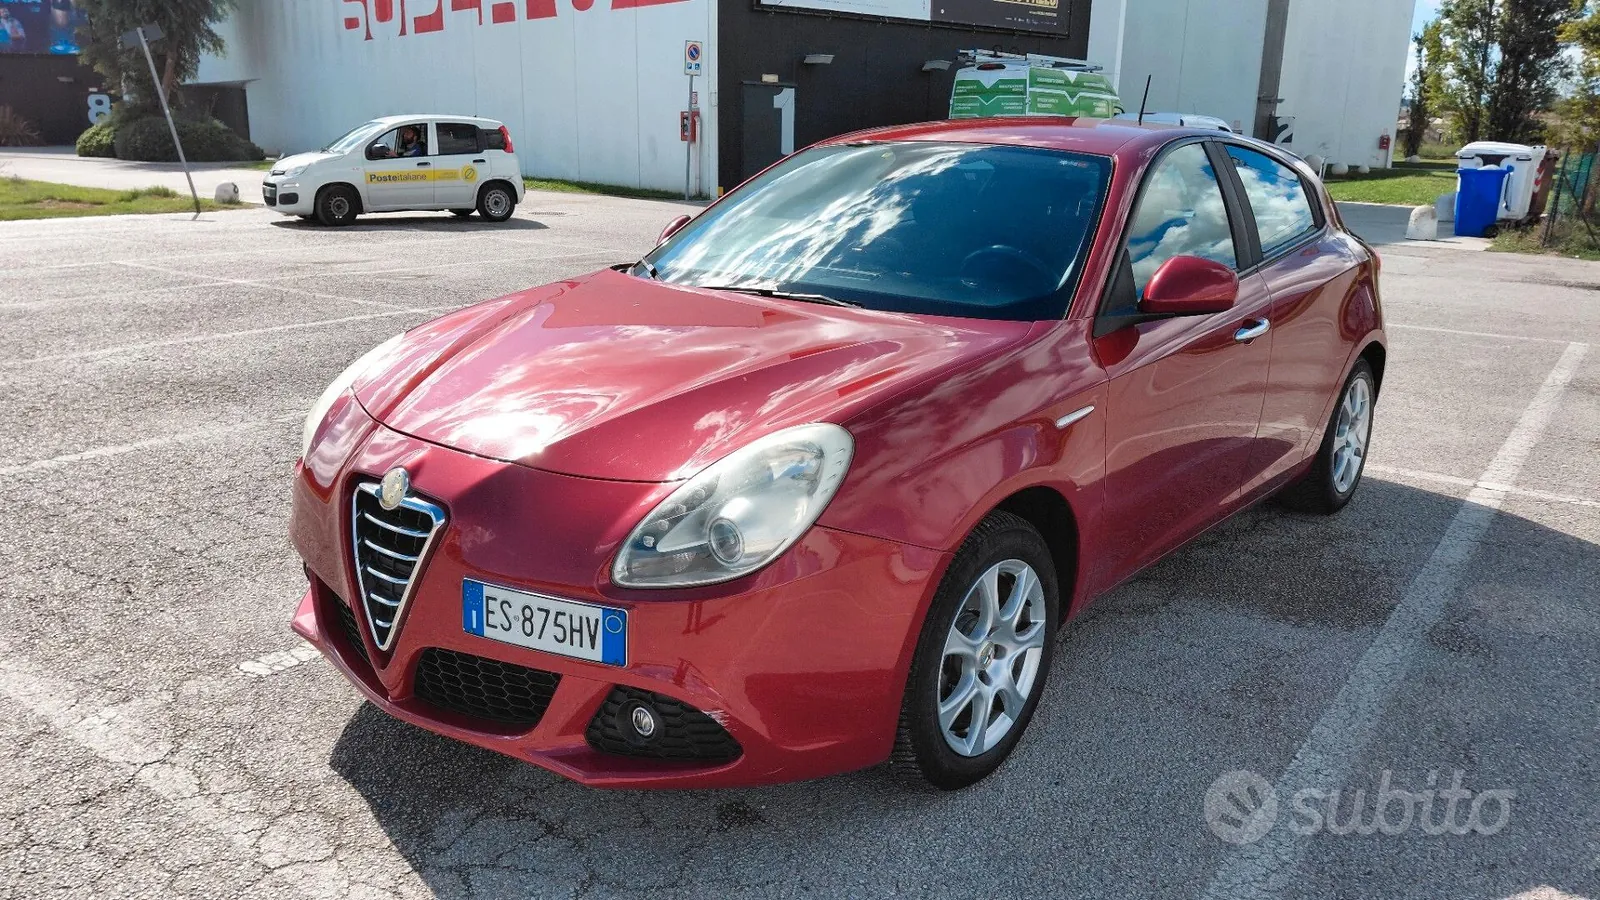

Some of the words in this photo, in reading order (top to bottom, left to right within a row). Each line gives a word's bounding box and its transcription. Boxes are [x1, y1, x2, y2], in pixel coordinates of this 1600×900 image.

[87, 94, 112, 124] 8
[774, 88, 795, 155] 1
[485, 596, 512, 632] ES
[521, 605, 599, 650] 875HV
